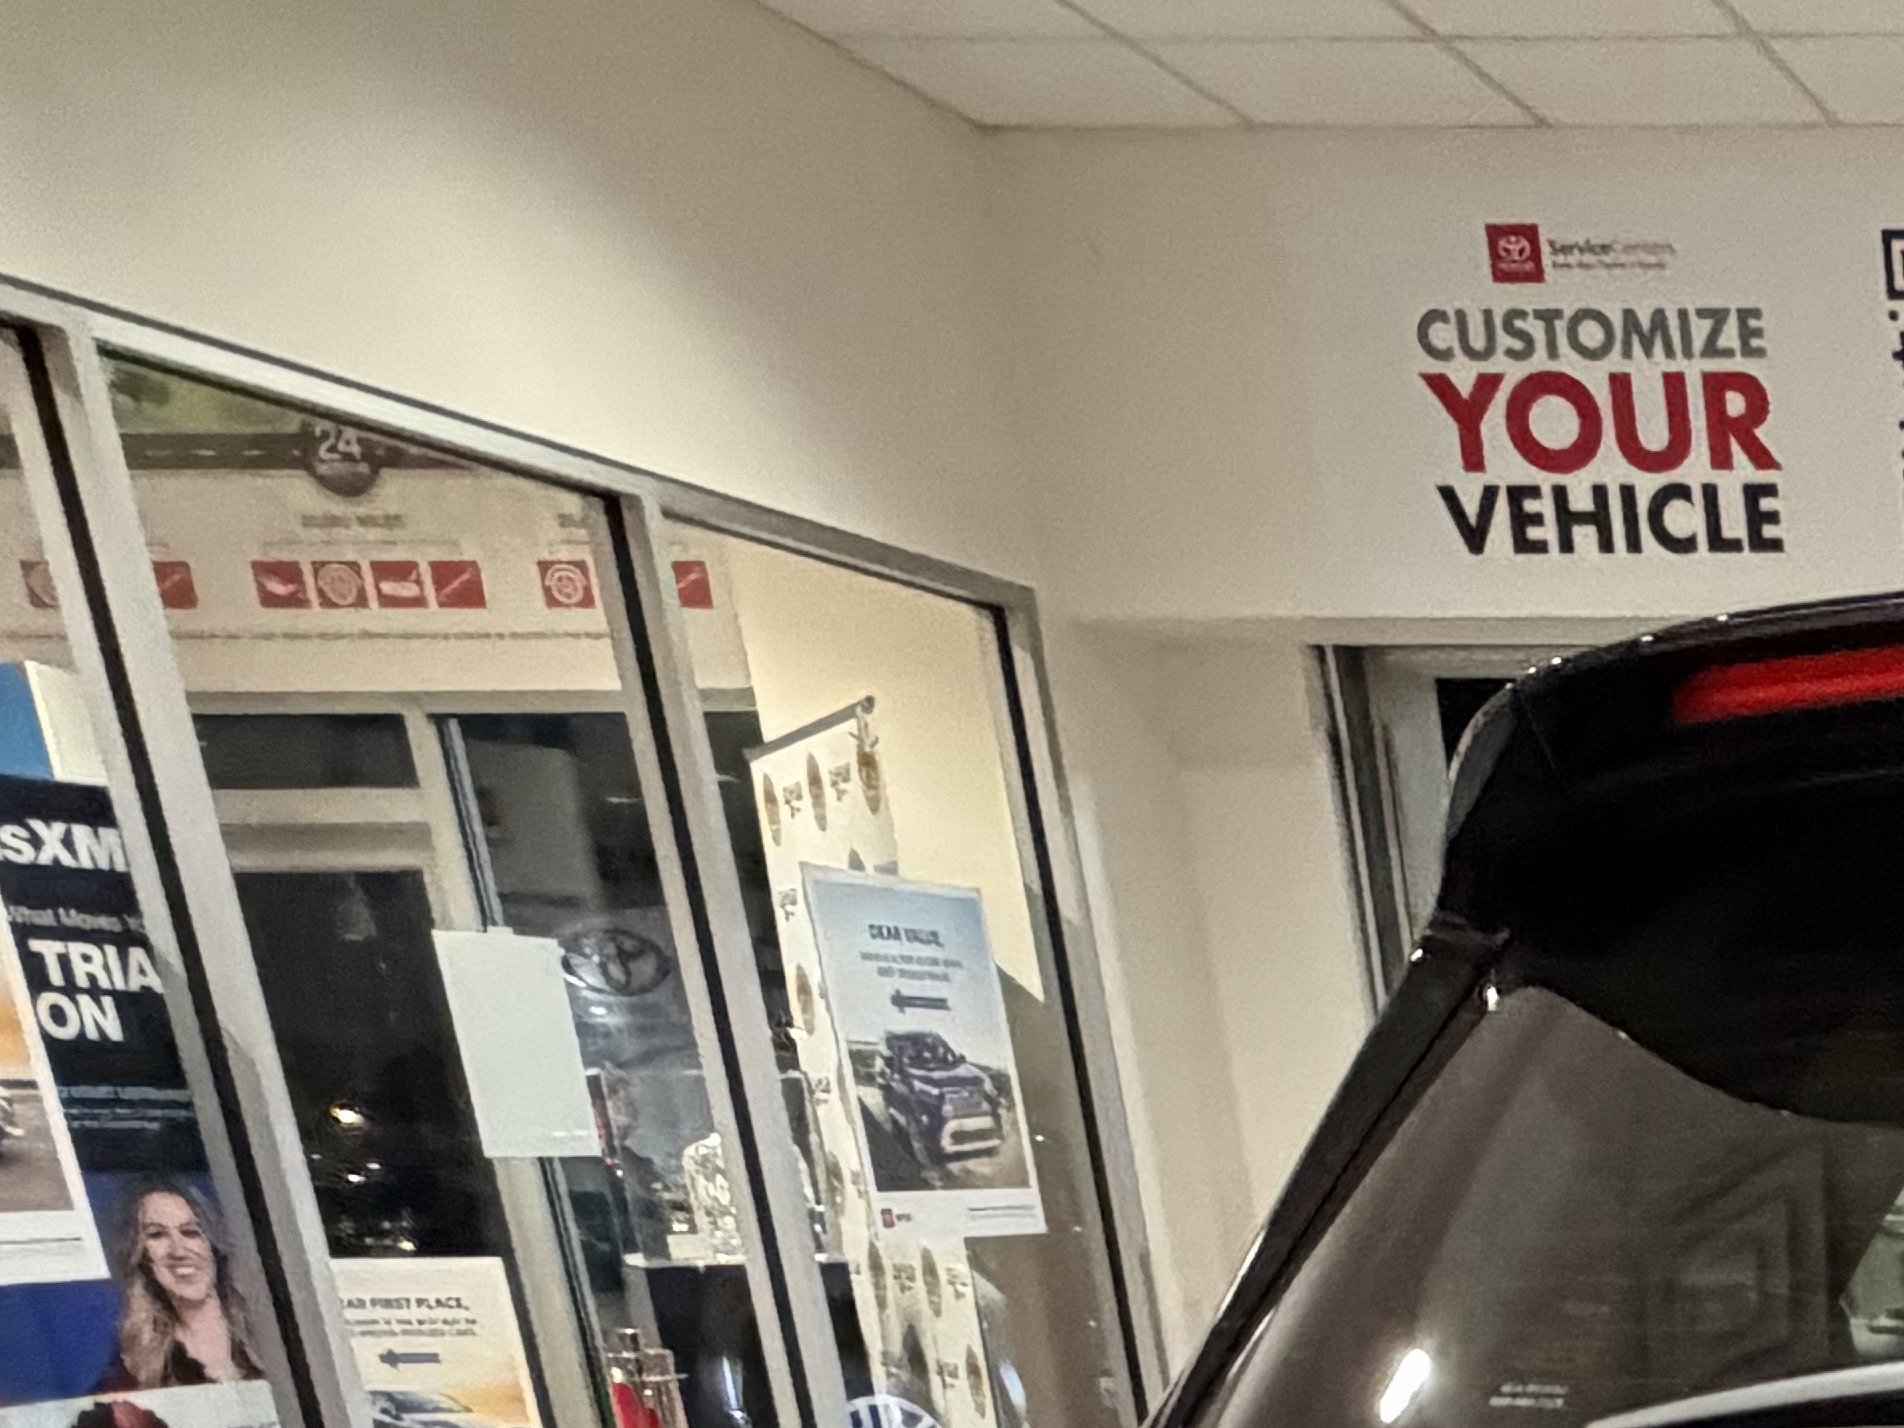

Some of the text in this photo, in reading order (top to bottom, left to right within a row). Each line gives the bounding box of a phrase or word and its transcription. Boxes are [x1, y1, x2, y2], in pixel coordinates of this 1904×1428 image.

[1417, 308, 1766, 361] CUSTOMIZE
[1419, 370, 1782, 473] YOUR
[1436, 483, 1784, 554] VEHICLE
[37, 992, 124, 1042] ON
